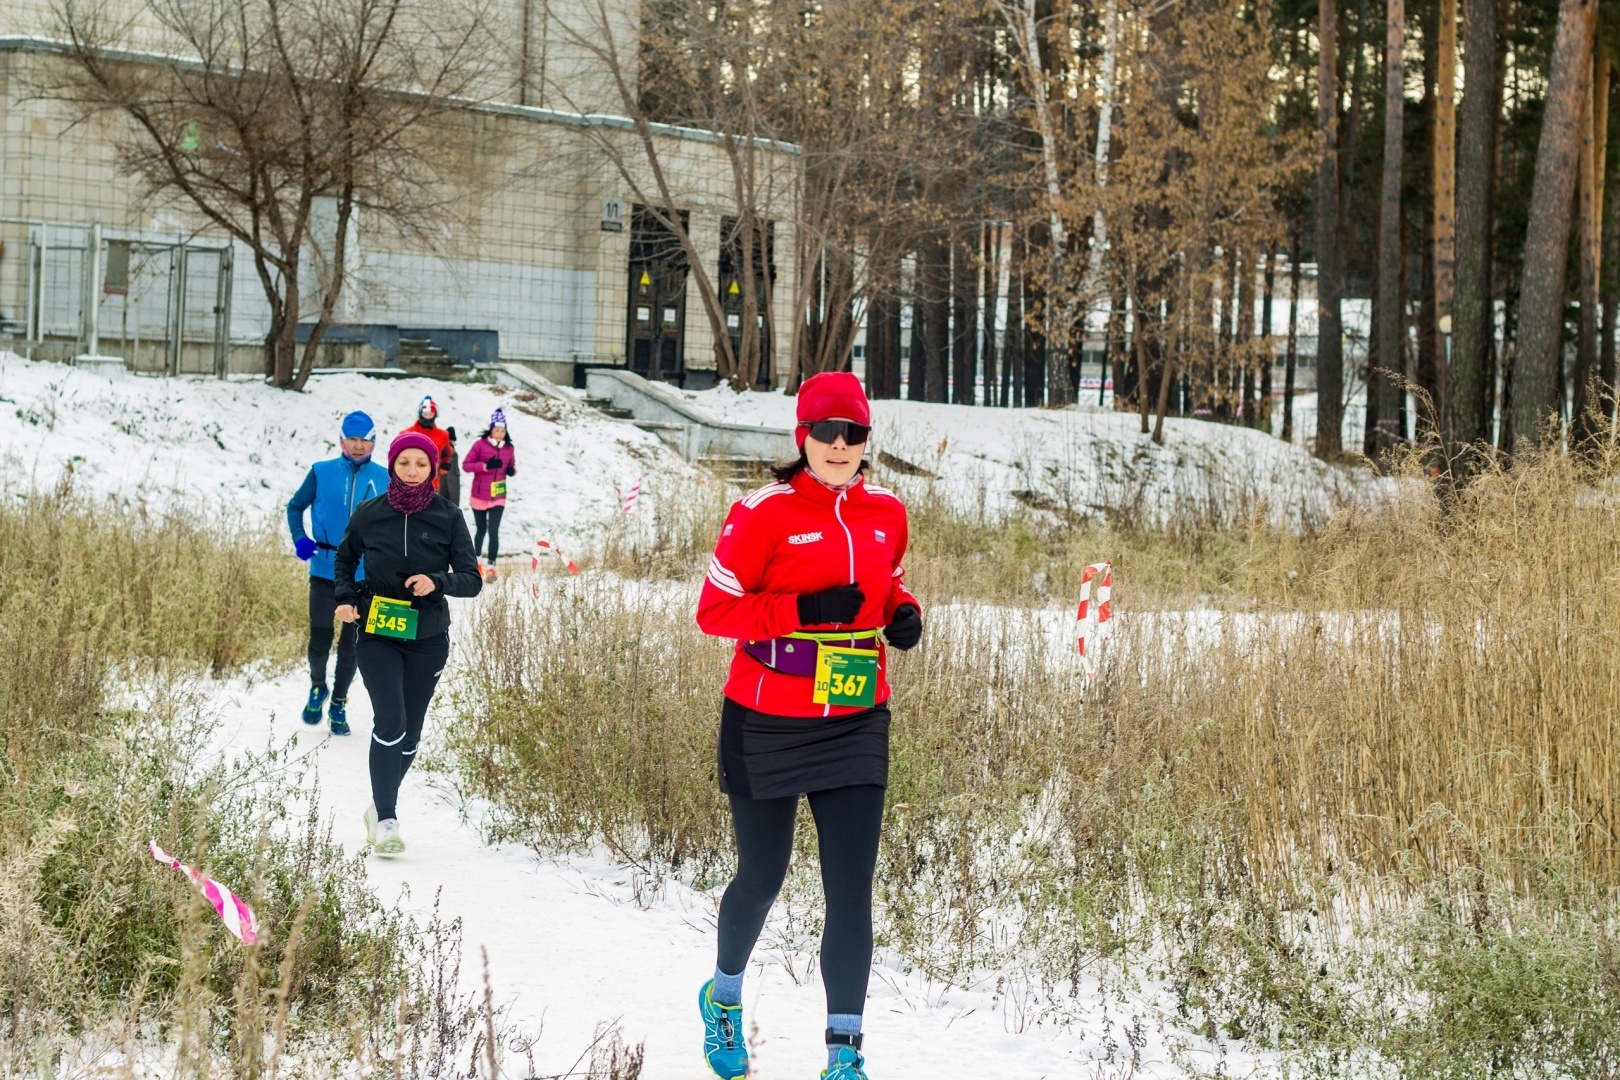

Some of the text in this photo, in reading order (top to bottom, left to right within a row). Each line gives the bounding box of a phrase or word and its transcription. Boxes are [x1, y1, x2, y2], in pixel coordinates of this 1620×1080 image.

[788, 531, 824, 544] SKINSK
[368, 617, 376, 626] 10
[376, 614, 407, 632] 345
[816, 680, 829, 691] 10
[830, 673, 868, 697] 367
